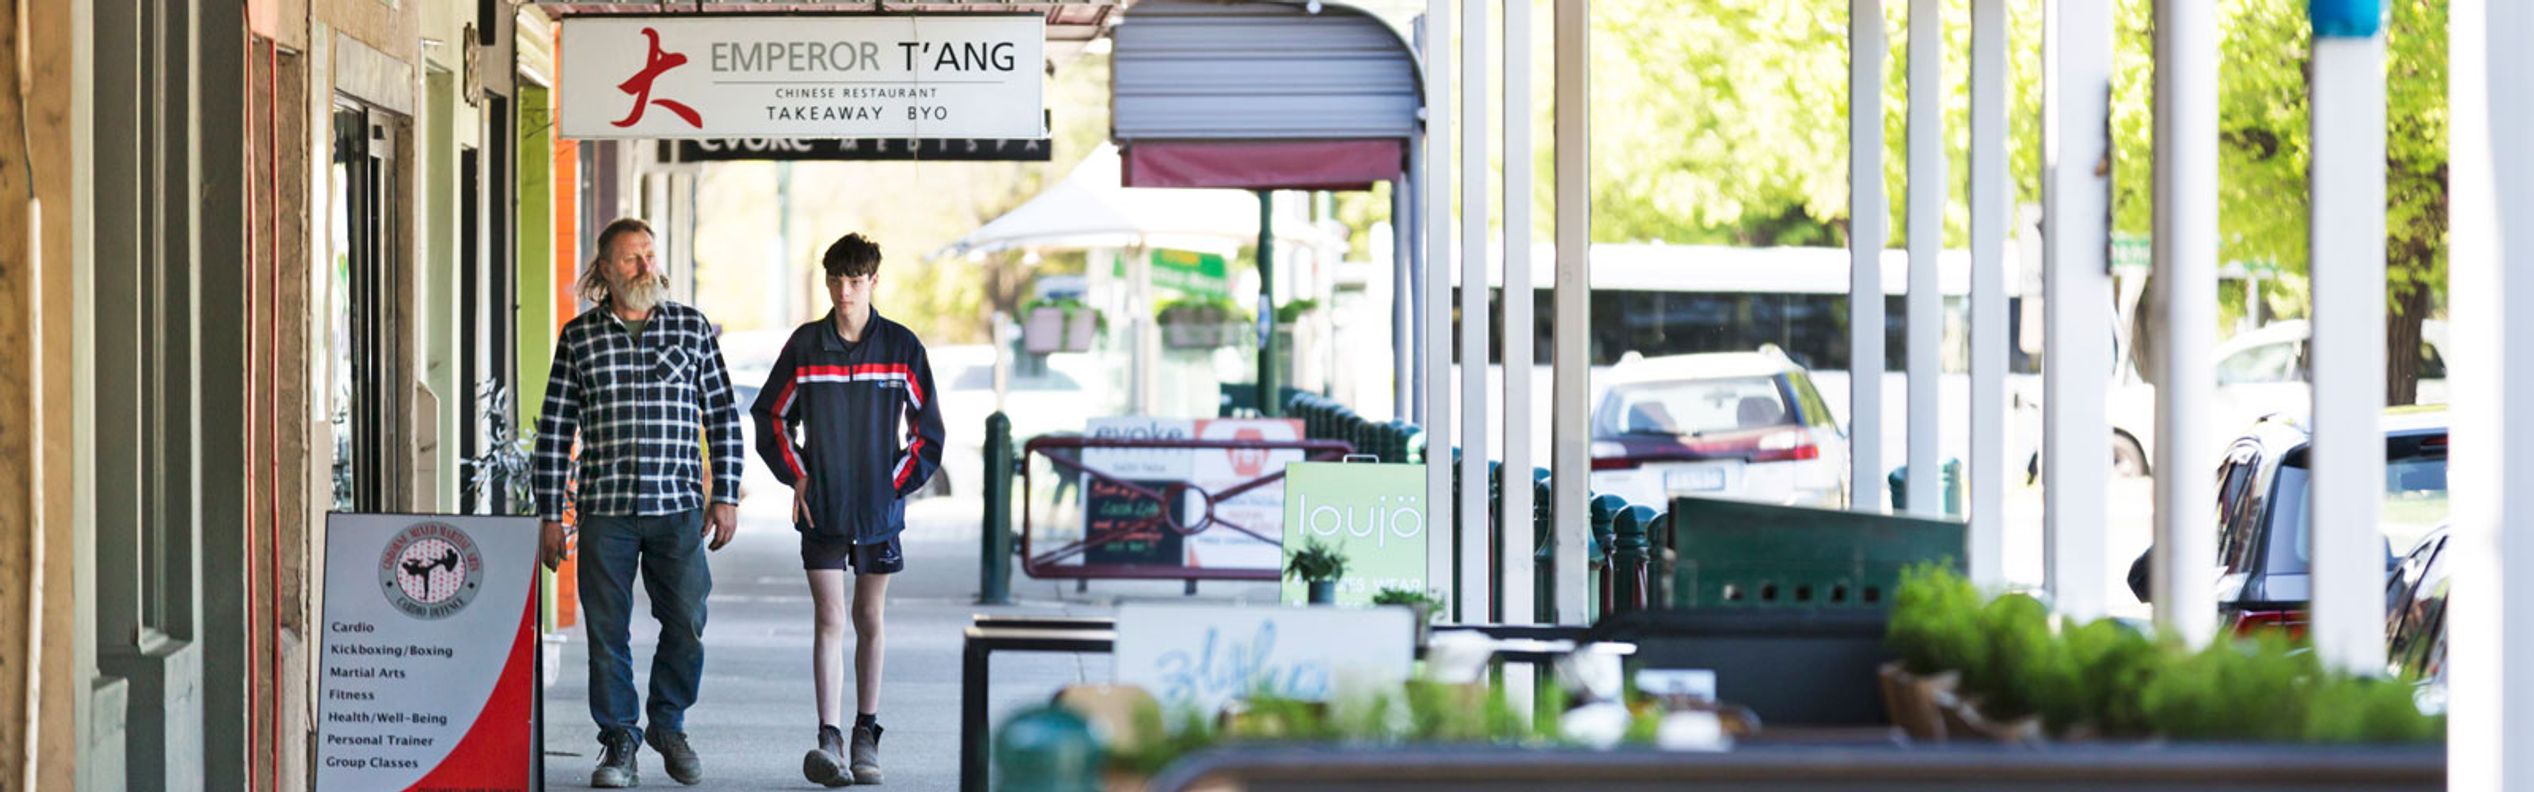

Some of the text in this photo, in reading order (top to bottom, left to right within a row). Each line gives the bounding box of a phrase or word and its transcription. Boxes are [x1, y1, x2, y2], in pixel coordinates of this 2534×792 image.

[711, 41, 1015, 72] EMPEROR T'ANG
[775, 88, 937, 99] CHINESE RESTAURANT
[767, 106, 948, 121] TAKEAWAY BYO
[1298, 494, 1422, 548] loujö
[332, 622, 375, 633] Cardio
[331, 644, 453, 658] Kickboxing/Boxing
[330, 667, 406, 679] Martial Arts
[329, 689, 375, 700] Fitness
[328, 712, 448, 726] Health/Well-Being
[327, 734, 435, 747] Personal Trainer
[326, 756, 418, 769] Group Classes
